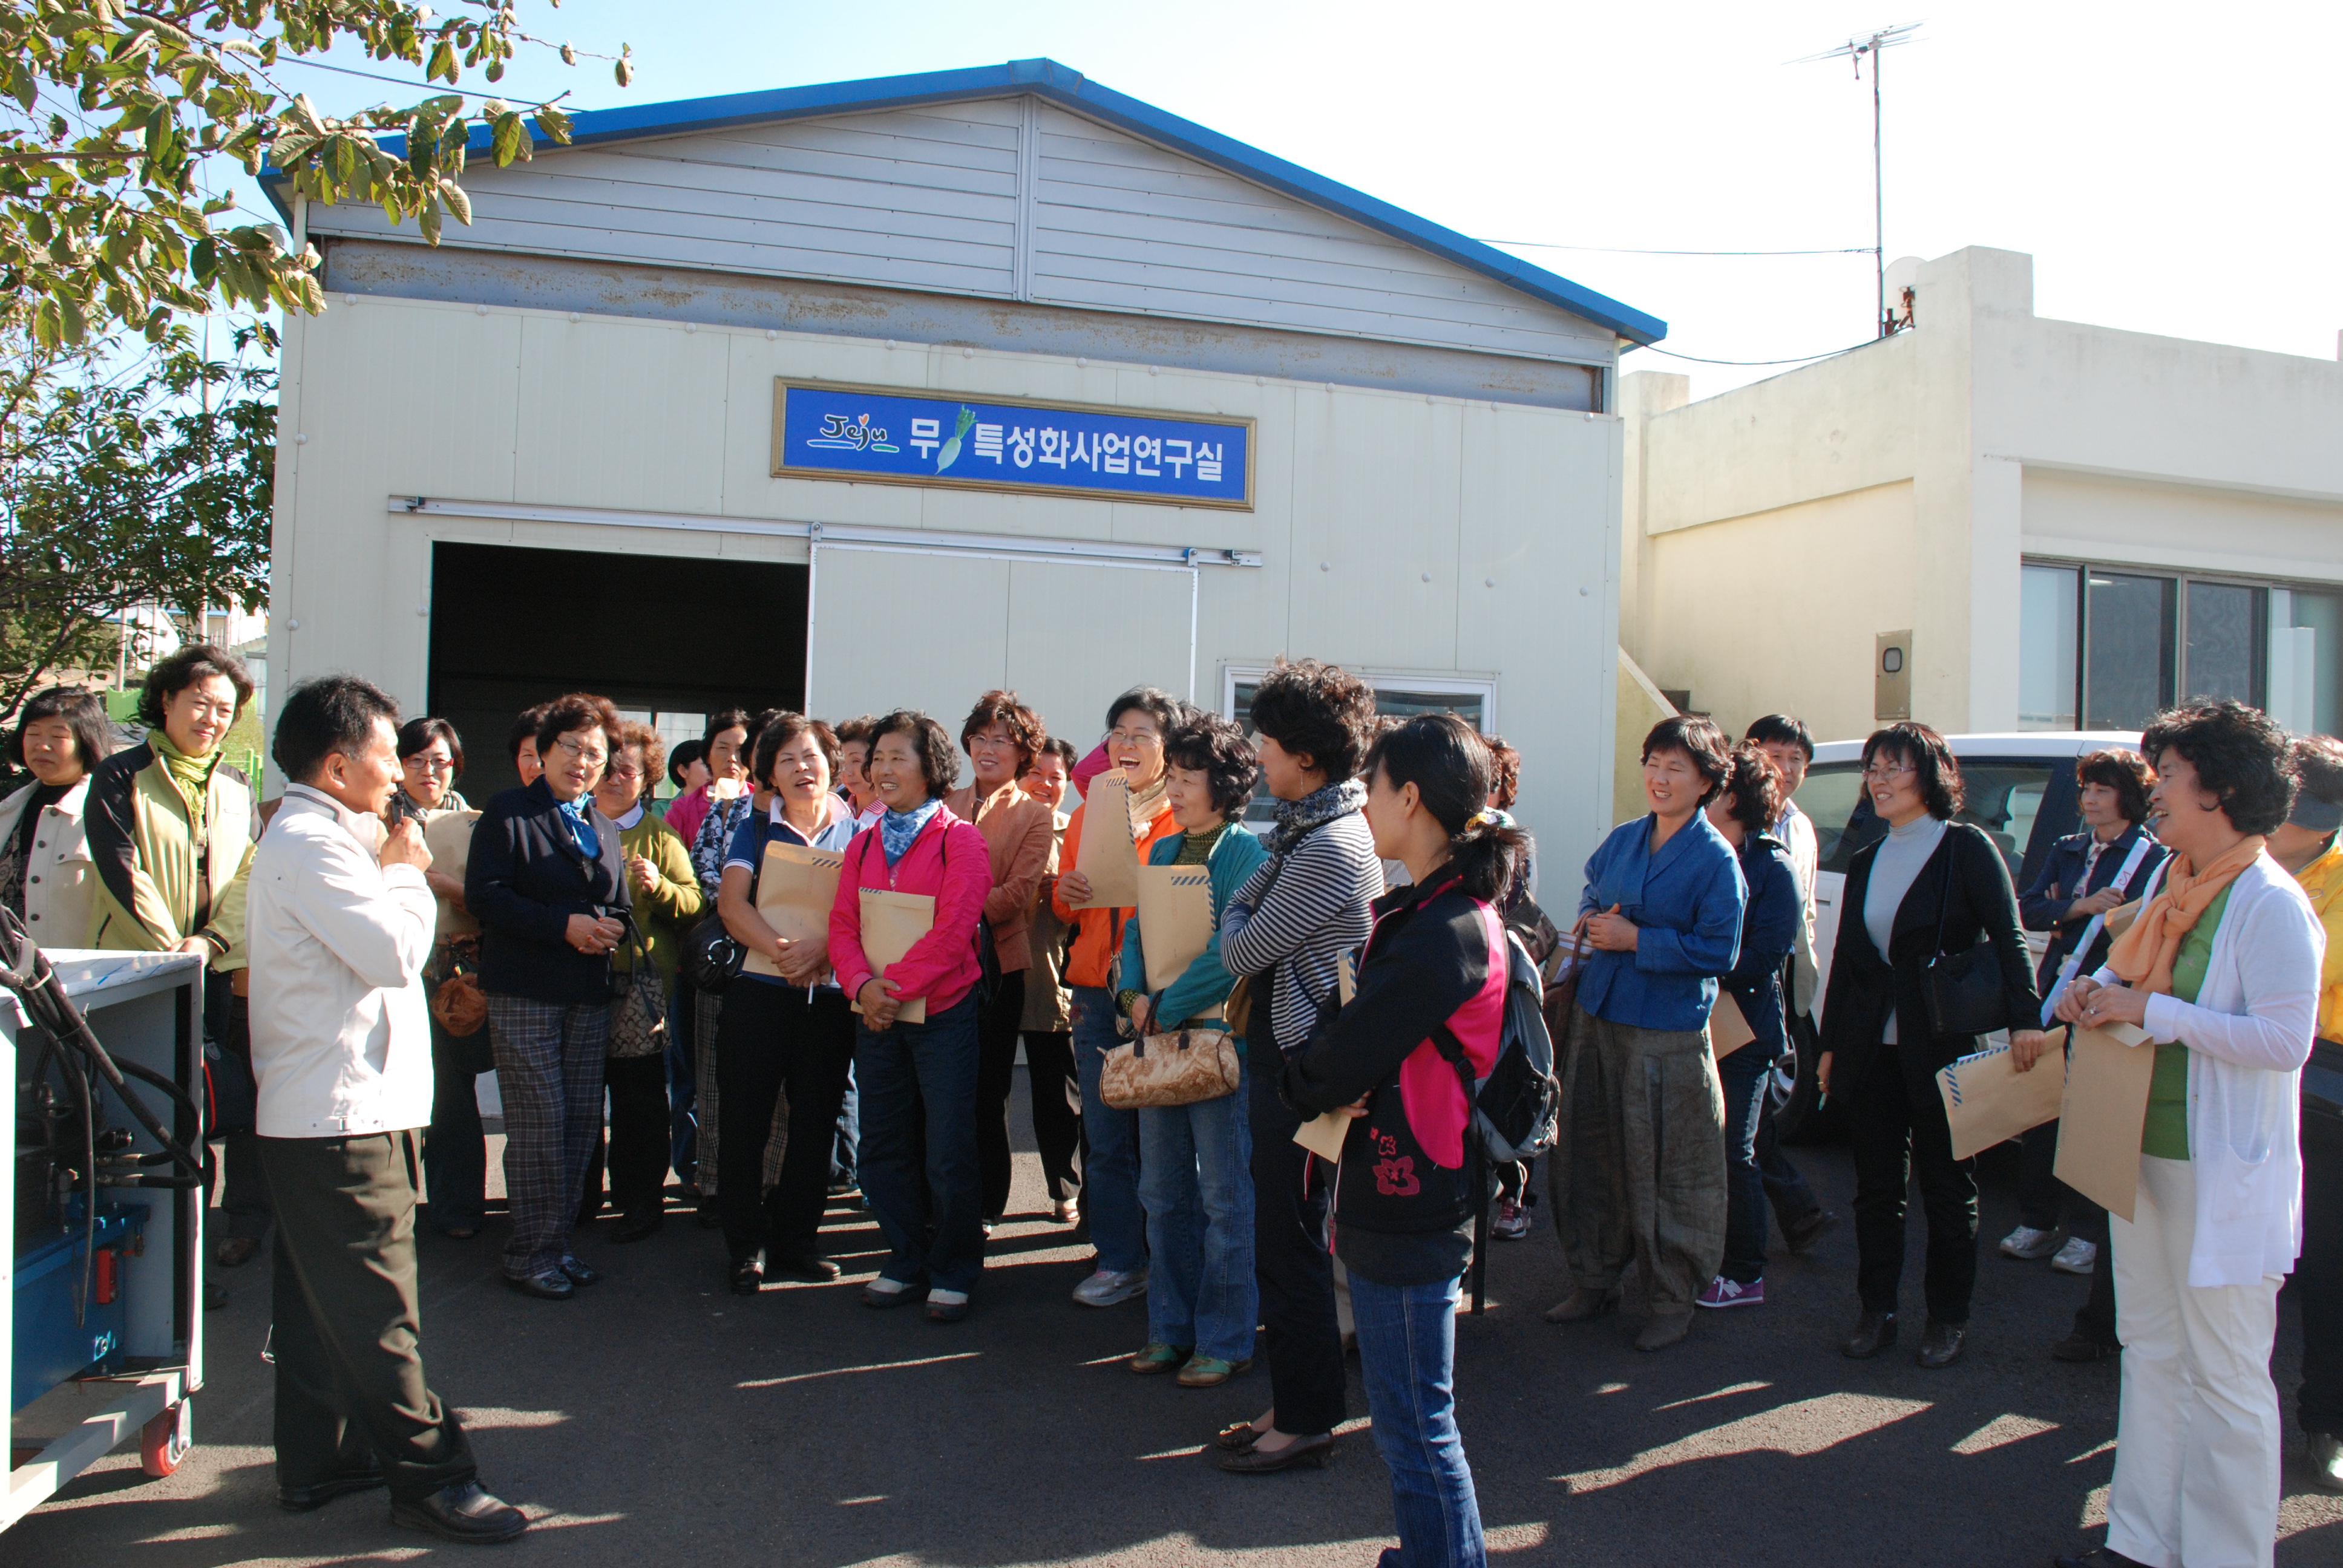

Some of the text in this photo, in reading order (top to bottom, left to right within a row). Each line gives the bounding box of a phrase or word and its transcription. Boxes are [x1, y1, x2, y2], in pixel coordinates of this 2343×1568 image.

[820, 413, 1222, 482] Jeju 무 특성화사업연구실
